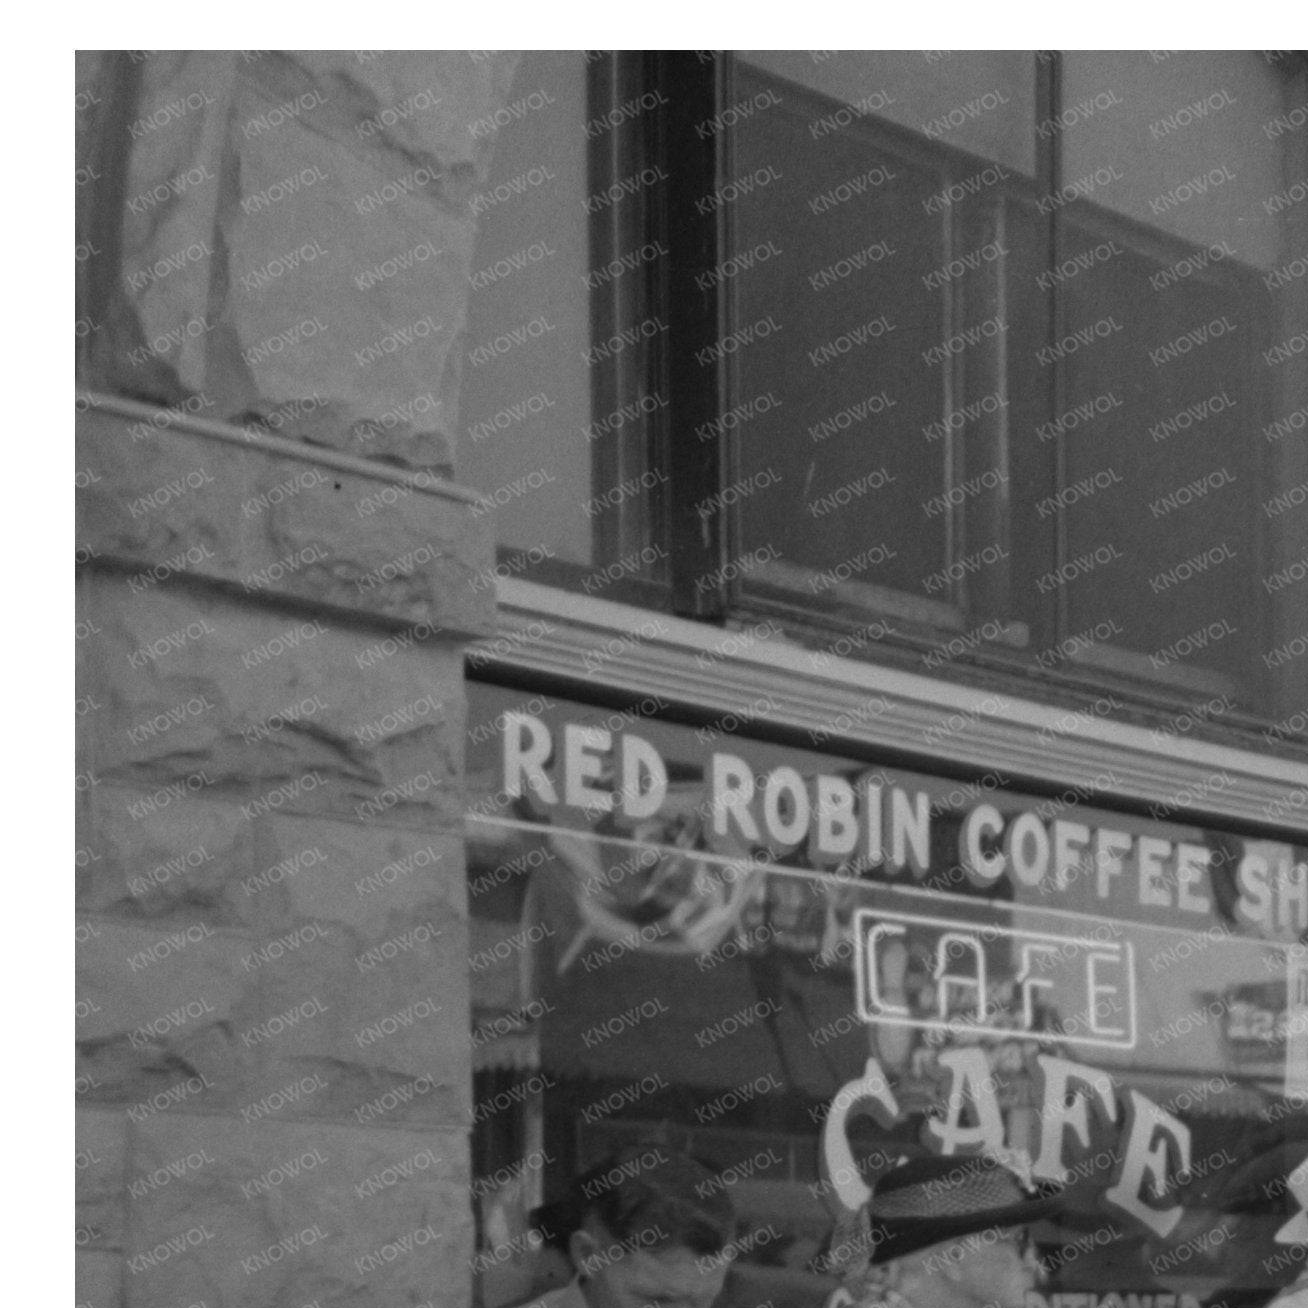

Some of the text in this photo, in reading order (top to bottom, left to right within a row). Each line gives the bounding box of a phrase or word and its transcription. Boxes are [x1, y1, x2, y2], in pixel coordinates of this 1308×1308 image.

[503, 710, 667, 818] RED
[712, 753, 930, 873] ROBIN
[965, 803, 1212, 914] COFFEE
[867, 923, 1126, 1036] CAFE
[822, 1046, 1192, 1238] CAFE
